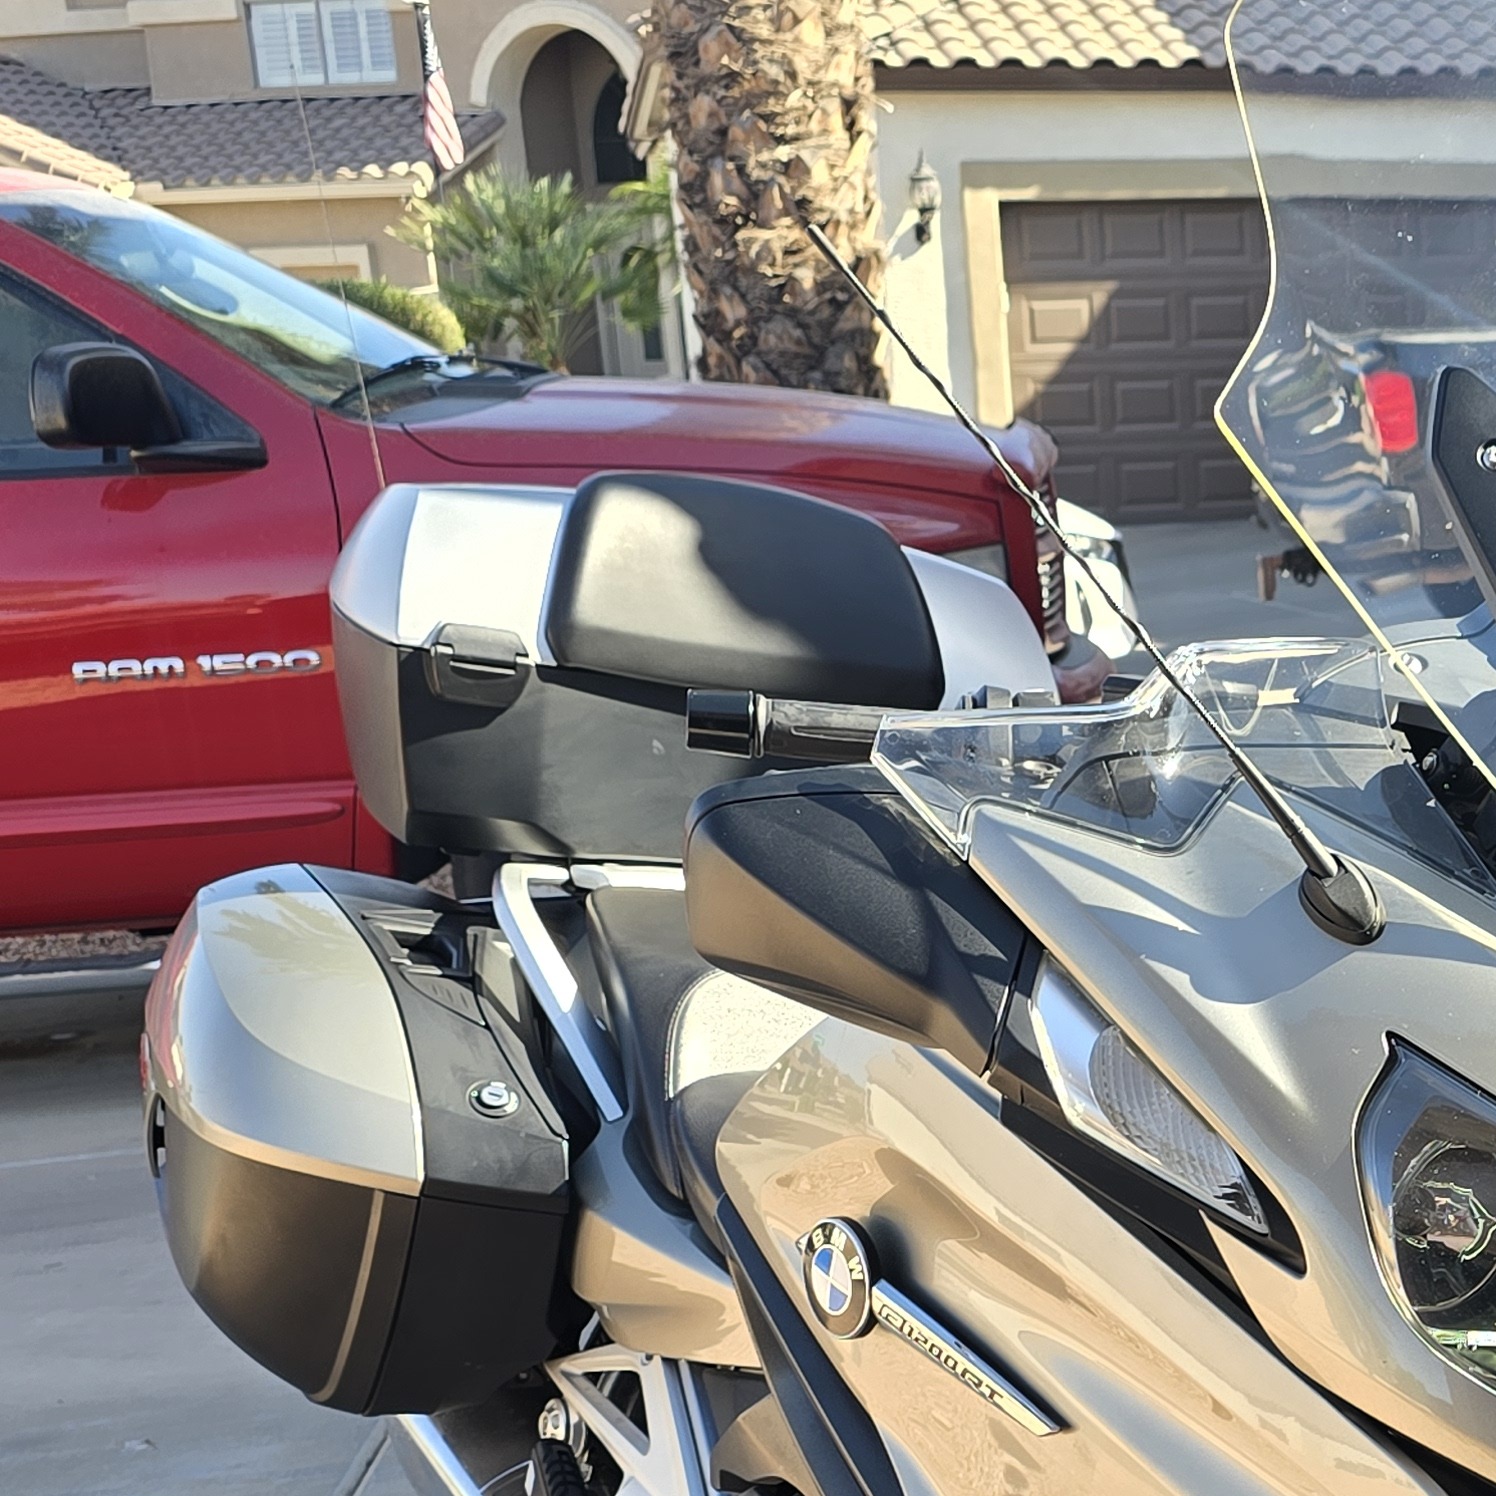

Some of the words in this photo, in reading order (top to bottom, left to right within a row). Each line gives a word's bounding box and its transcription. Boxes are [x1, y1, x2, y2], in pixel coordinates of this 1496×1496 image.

[71, 655, 186, 685] RAM
[195, 648, 322, 677] 1500
[811, 1225, 865, 1281] BMW
